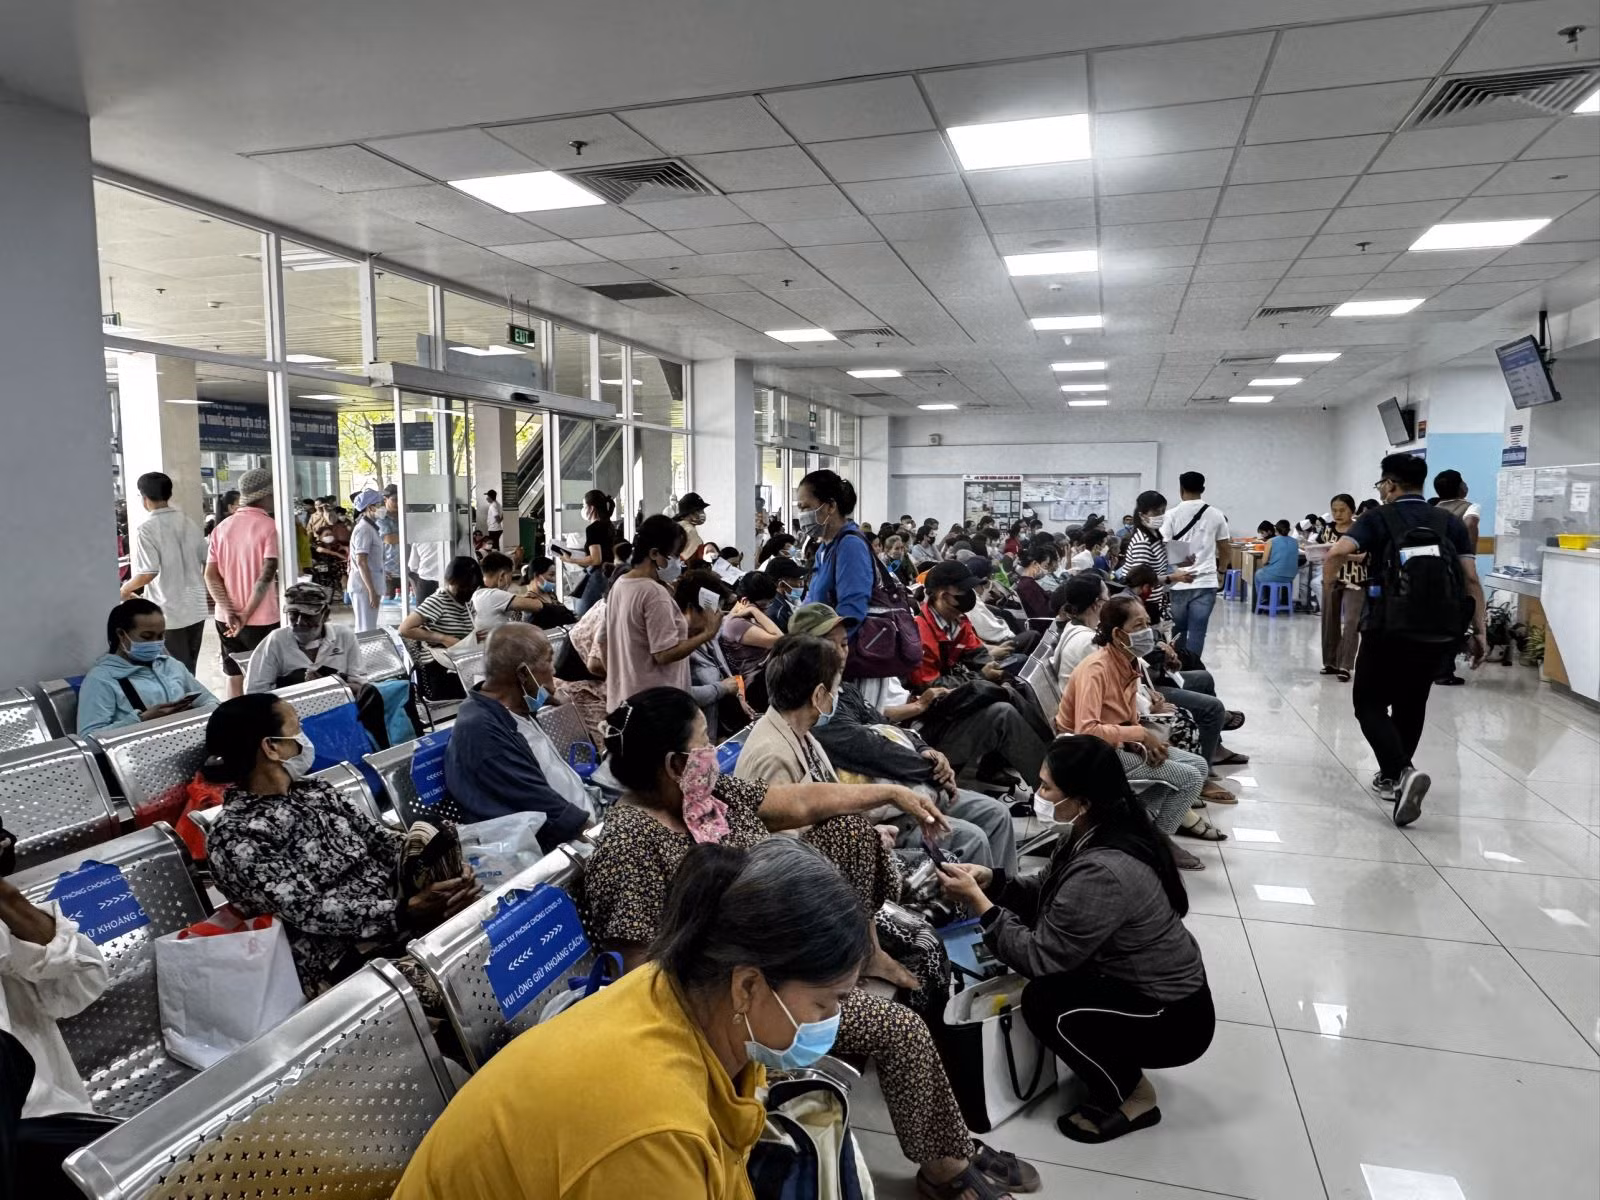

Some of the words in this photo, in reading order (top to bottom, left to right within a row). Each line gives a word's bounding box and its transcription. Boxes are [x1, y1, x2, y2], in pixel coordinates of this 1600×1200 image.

[514, 327, 529, 344] EXIT
[97, 912, 137, 934] KHOẢNG
[490, 940, 507, 957] CHUNG
[502, 992, 516, 1009] VUI
[514, 978, 534, 999] LÒNG
[532, 966, 545, 982] GIỮ
[544, 947, 569, 972] KHOẢNG
[568, 934, 585, 953] CÁCH
